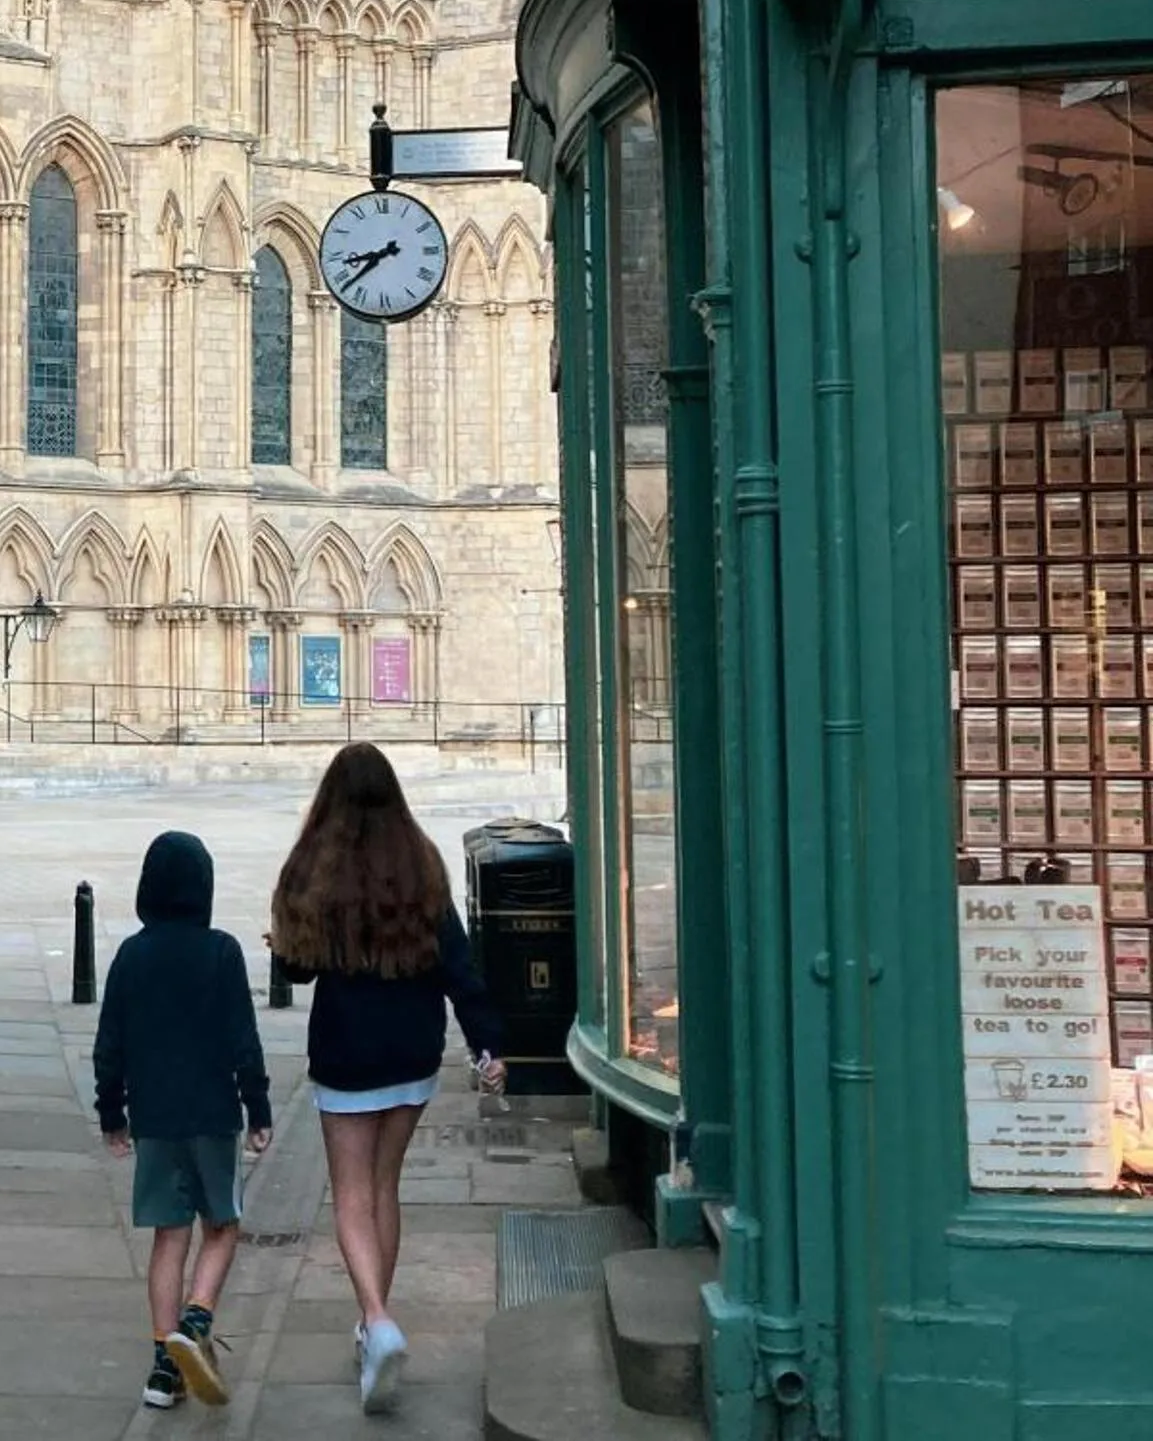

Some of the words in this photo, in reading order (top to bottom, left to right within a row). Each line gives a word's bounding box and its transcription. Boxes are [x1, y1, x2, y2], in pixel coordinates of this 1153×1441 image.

[966, 900, 1015, 921] Hot
[1036, 900, 1093, 921] Tea
[975, 947, 1022, 962] Pick
[1036, 949, 1088, 966] your
[983, 973, 1084, 988] favourite
[1004, 994, 1063, 1010] loose
[974, 1018, 1010, 1033] tea
[1026, 1018, 1048, 1033] to
[1064, 1019, 1098, 1038] go!
